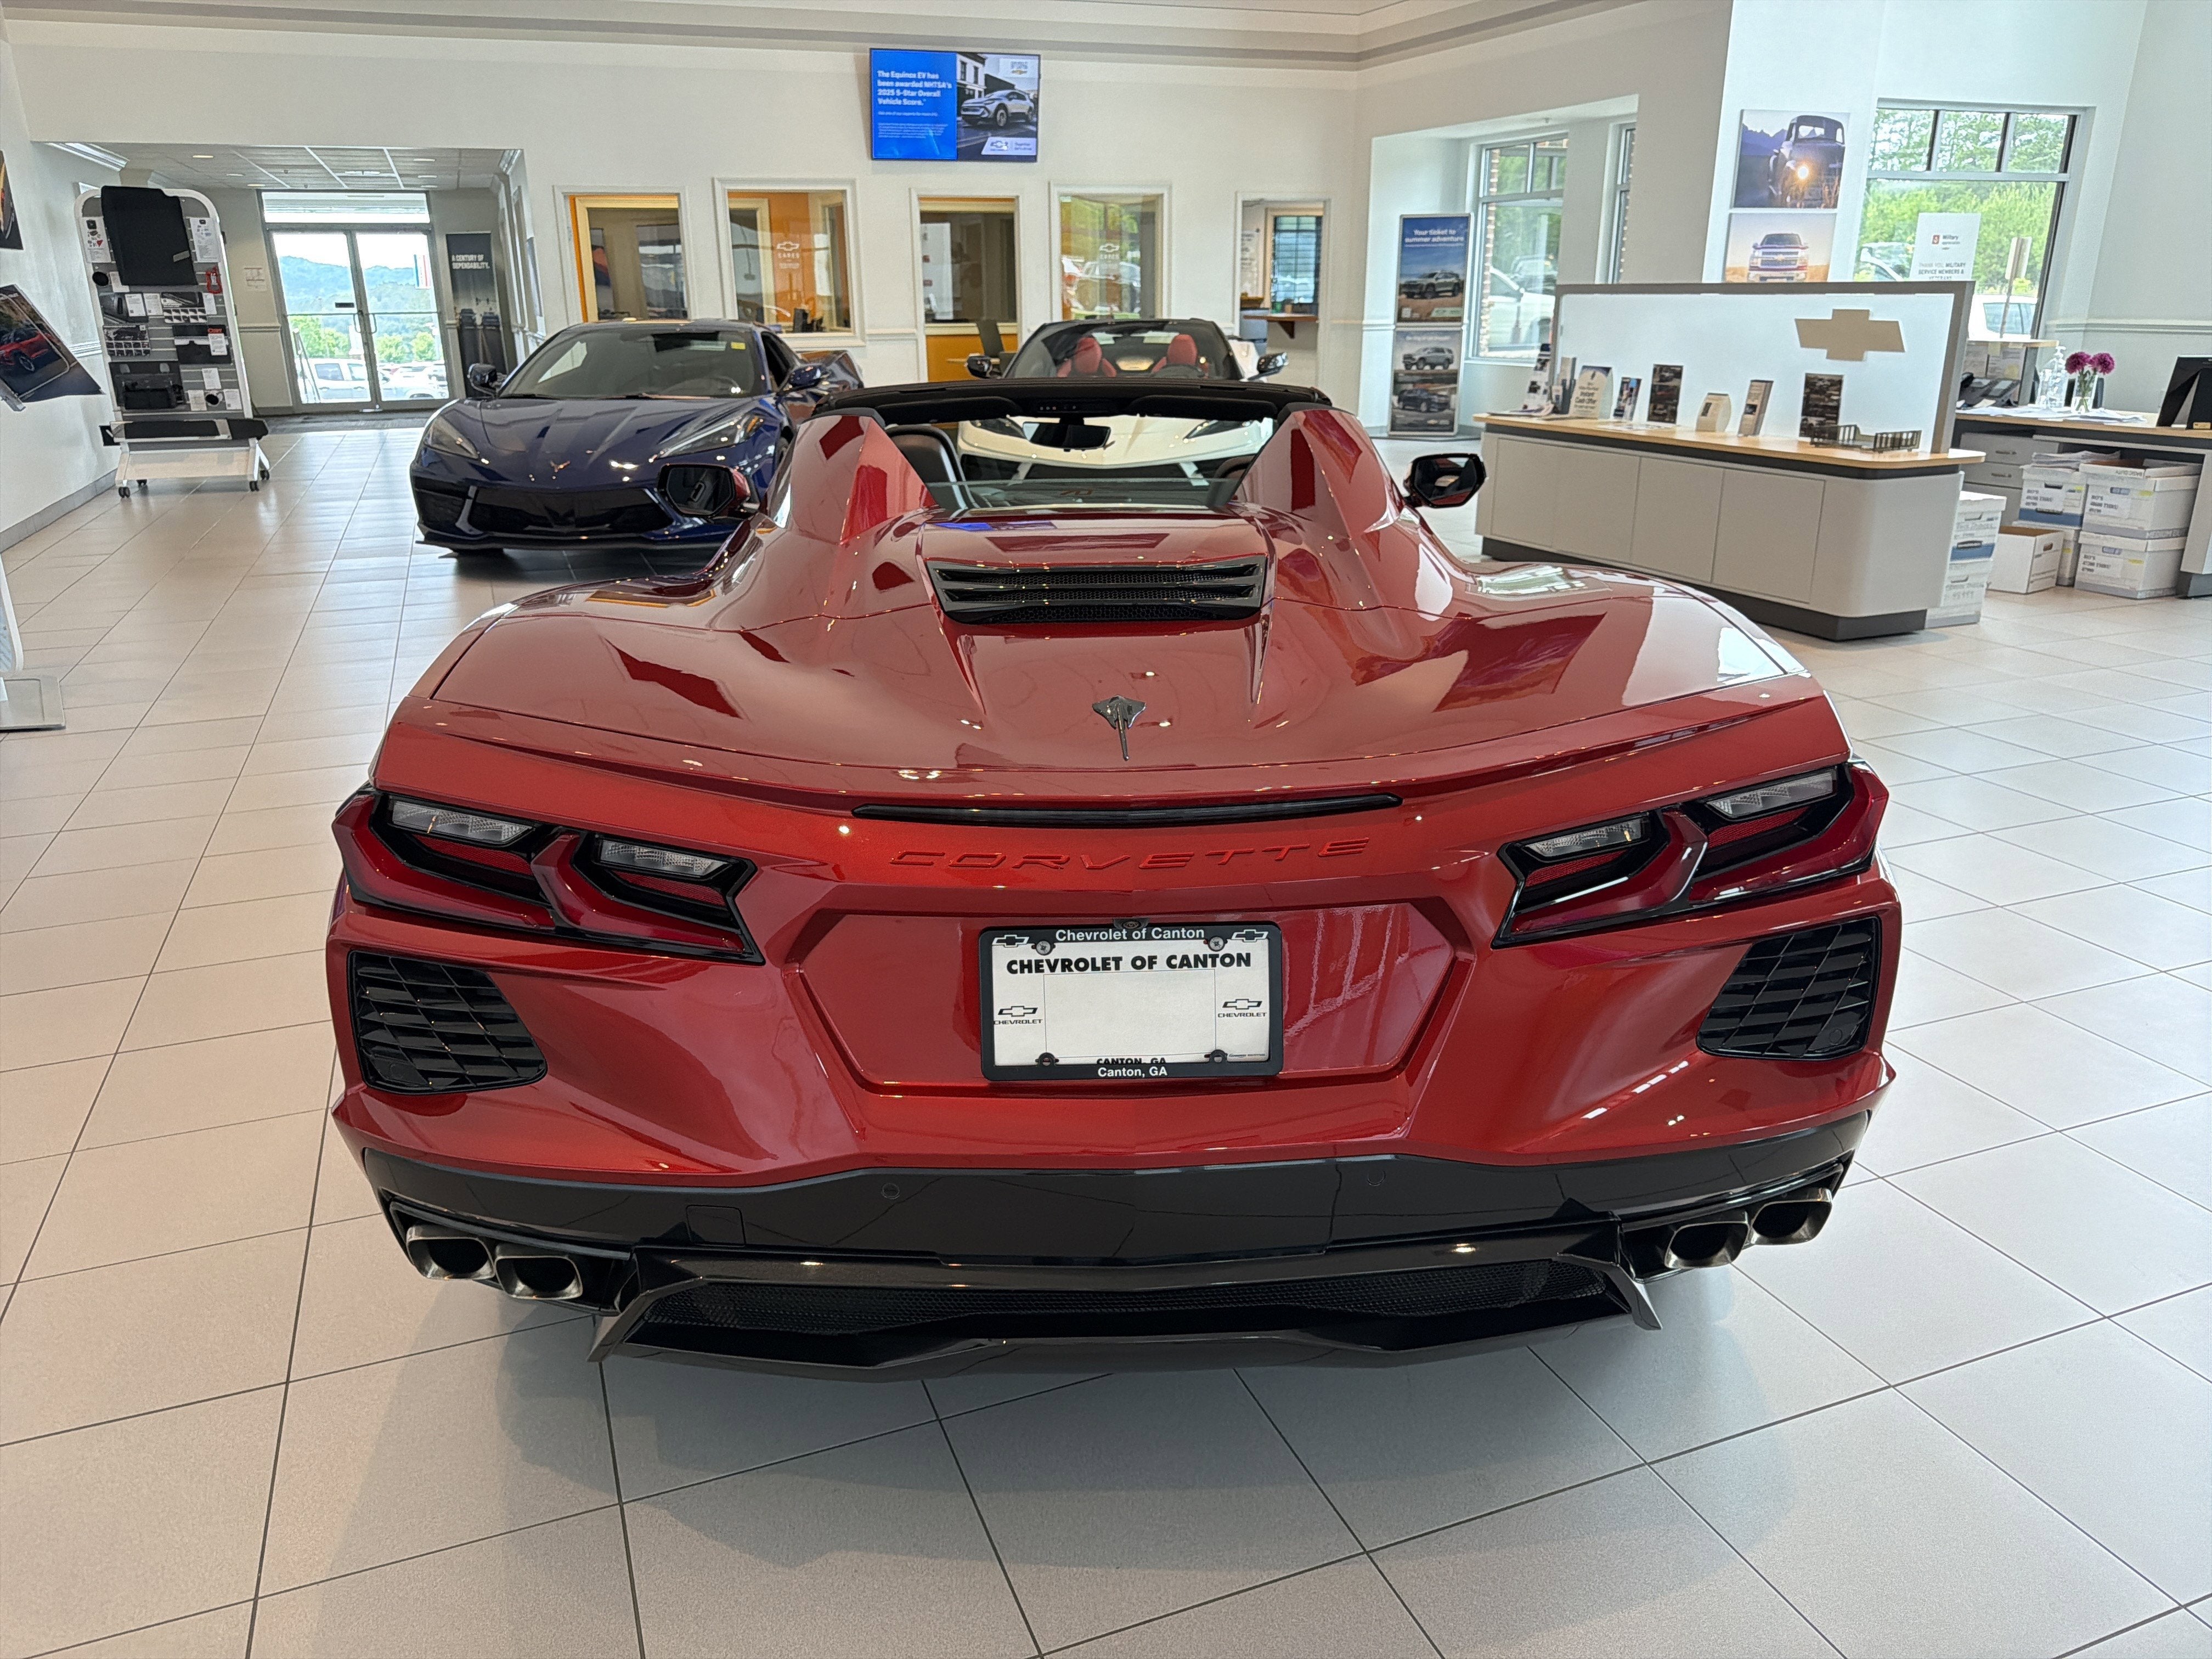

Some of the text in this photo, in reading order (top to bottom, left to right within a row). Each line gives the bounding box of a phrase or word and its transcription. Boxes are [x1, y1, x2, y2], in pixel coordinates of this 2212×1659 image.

[889, 837, 1370, 870] CORVETTE
[1055, 928, 1205, 942] Chevrolet of Canton
[1006, 952, 1251, 975] CHEVROLET OF CANTON
[1098, 1066, 1168, 1078] Canton, GA
